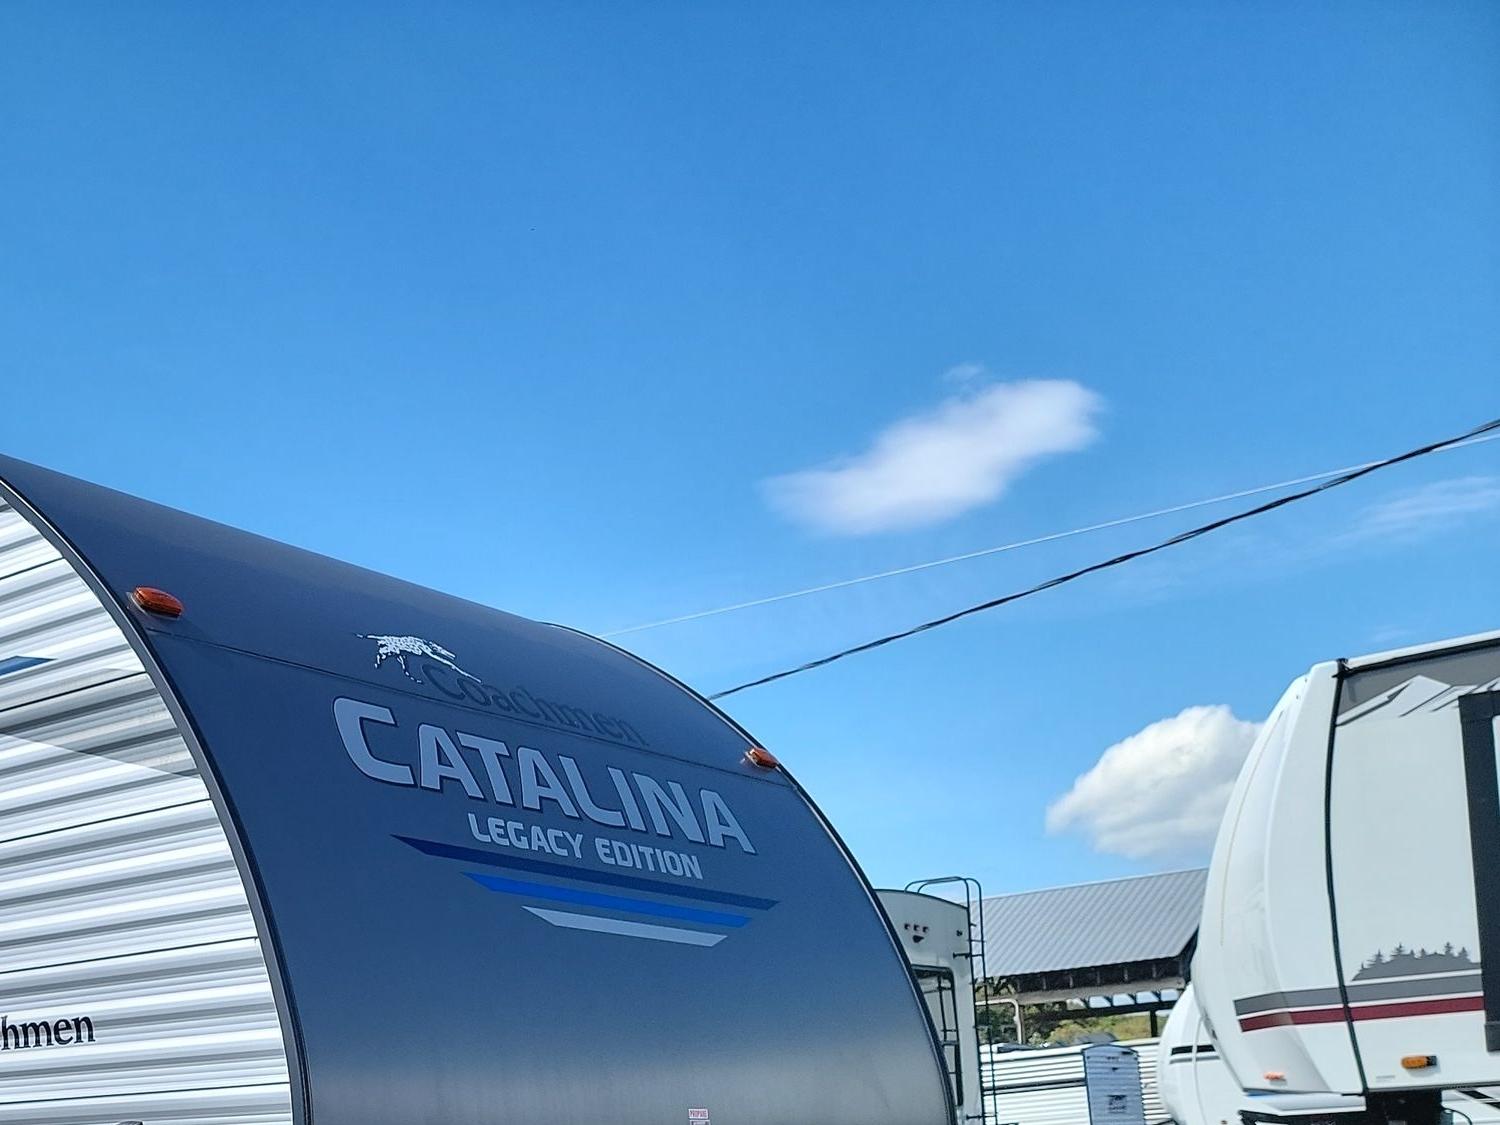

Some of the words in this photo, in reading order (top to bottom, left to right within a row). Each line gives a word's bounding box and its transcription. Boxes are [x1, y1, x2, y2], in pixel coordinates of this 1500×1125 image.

[421, 663, 649, 746] Coachmen
[332, 696, 757, 855] CATALINA
[467, 812, 584, 859] LEGACY
[594, 836, 704, 880] EDITION
